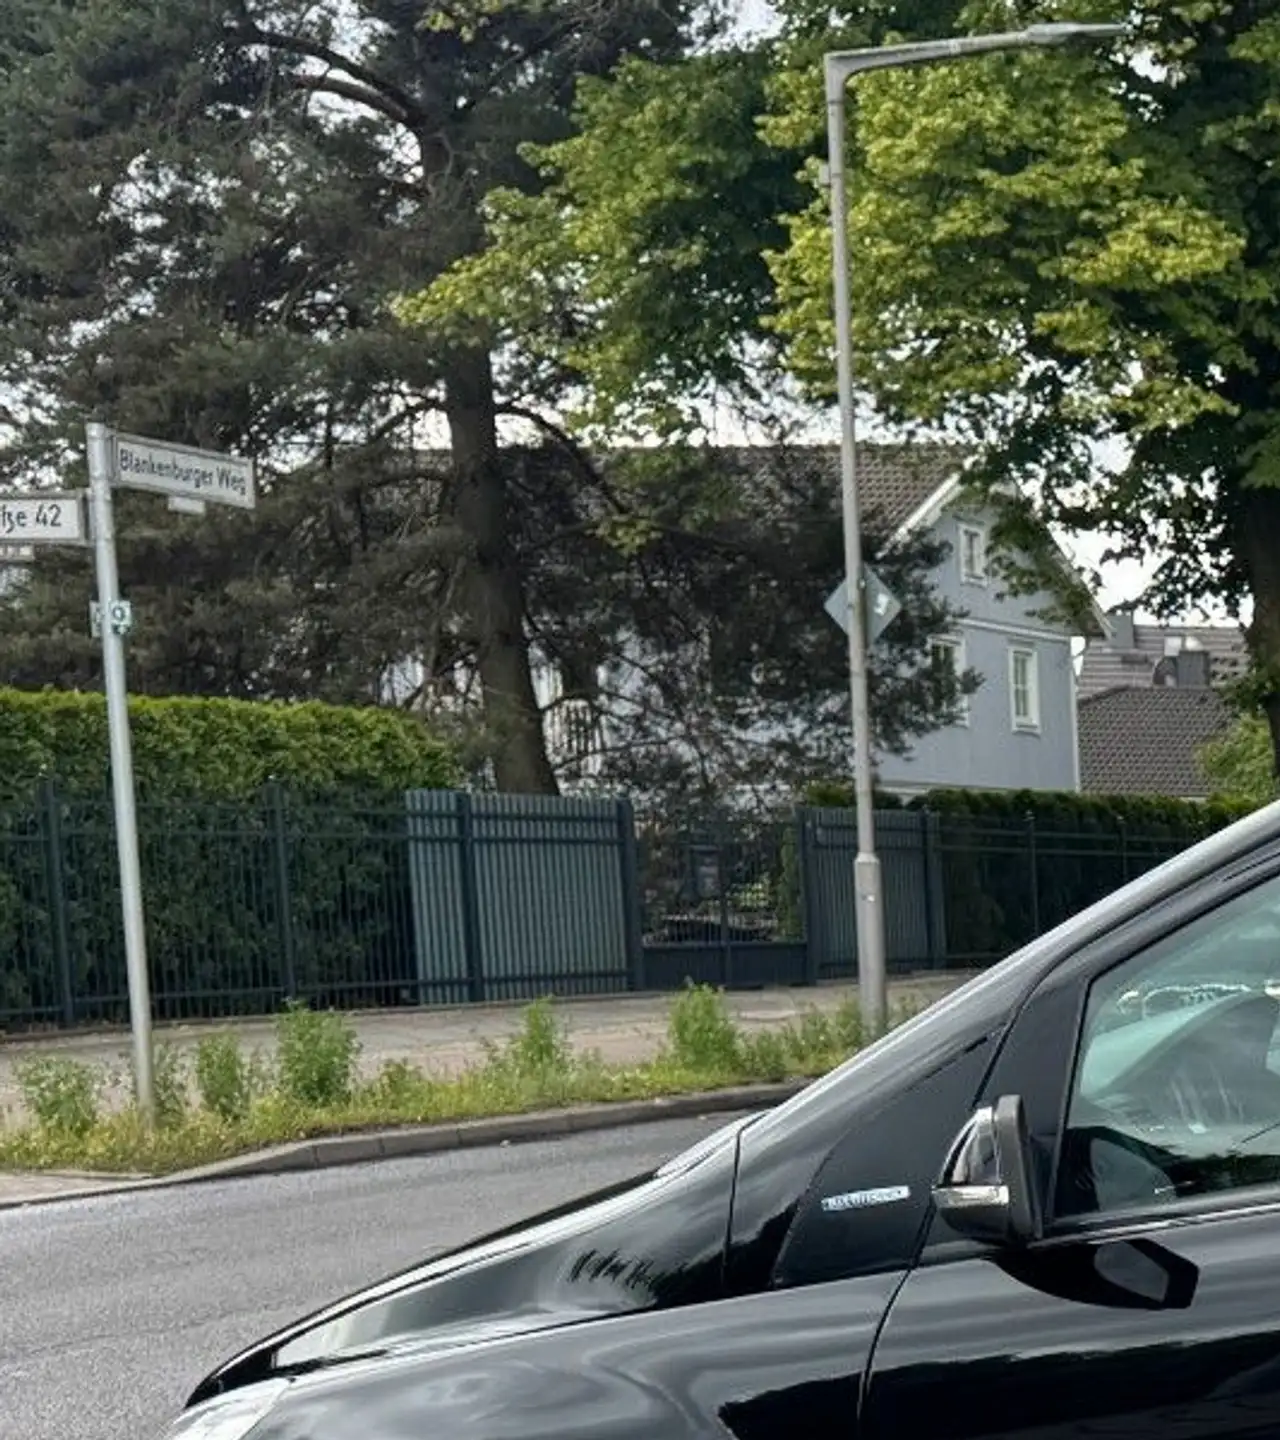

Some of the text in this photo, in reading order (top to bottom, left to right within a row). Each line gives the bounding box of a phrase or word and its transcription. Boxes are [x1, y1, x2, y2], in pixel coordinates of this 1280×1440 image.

[120, 447, 247, 497] Blankenburger Weg
[35, 503, 63, 528] 42
